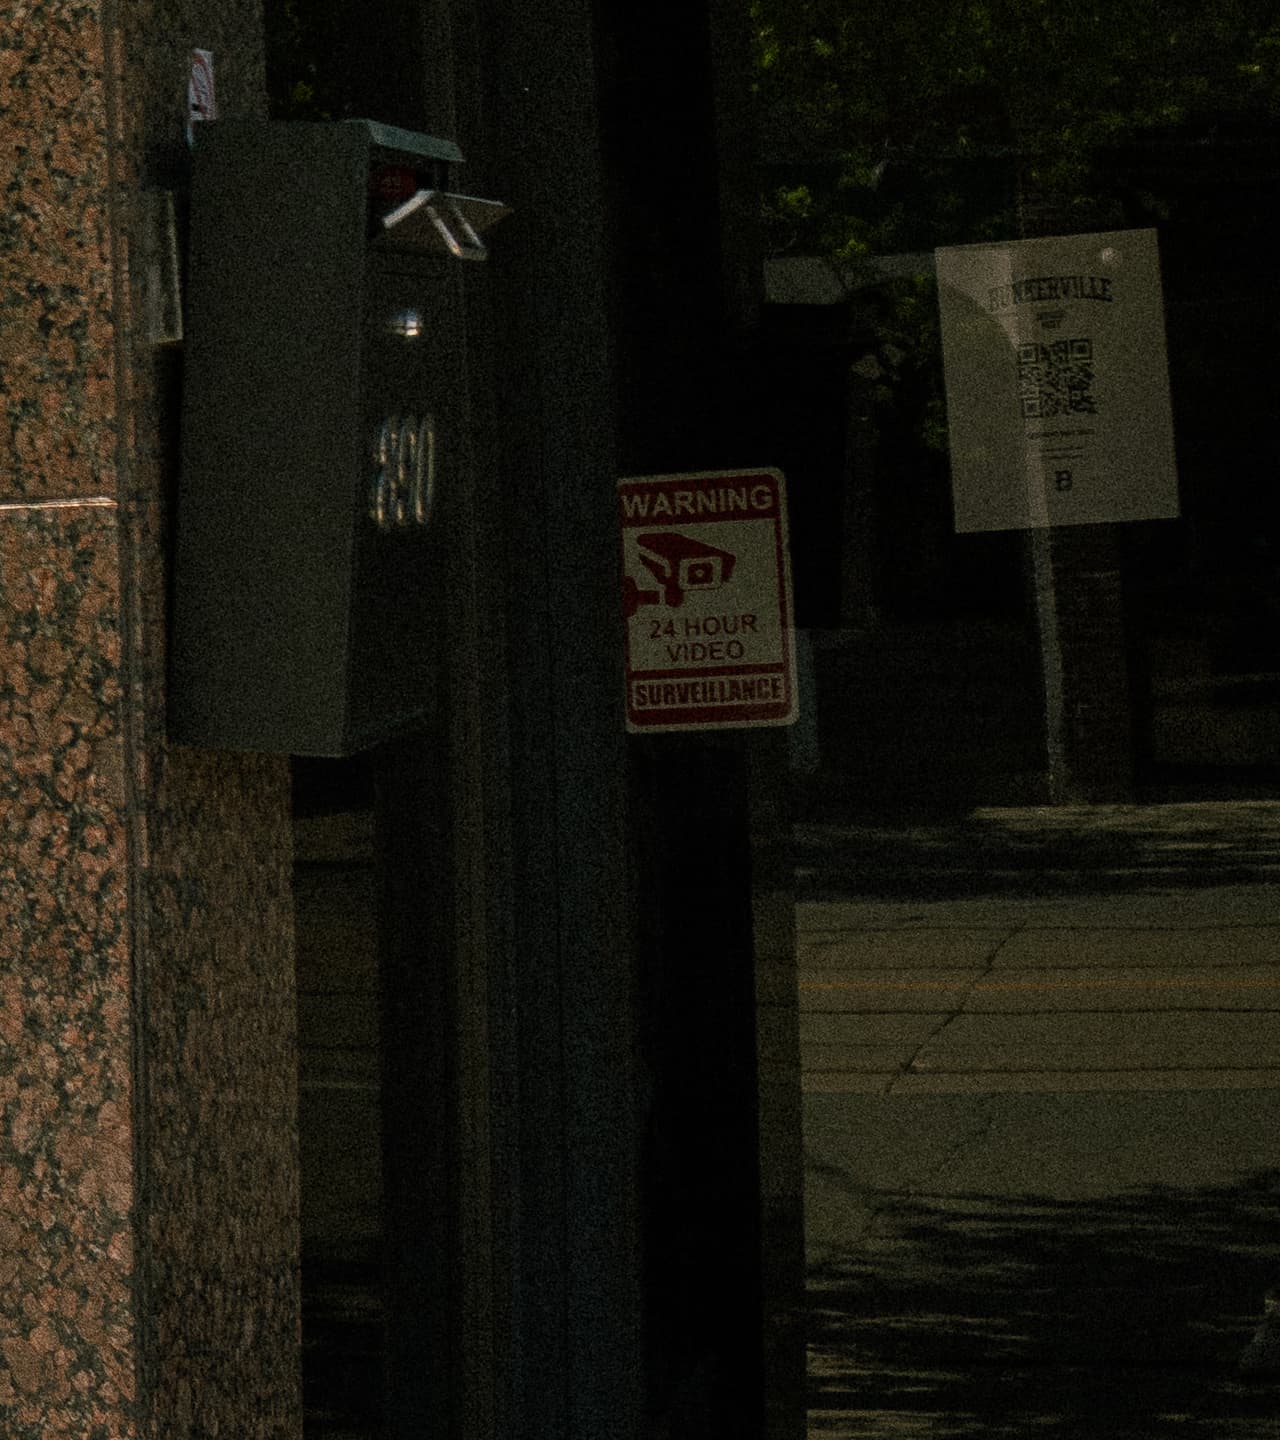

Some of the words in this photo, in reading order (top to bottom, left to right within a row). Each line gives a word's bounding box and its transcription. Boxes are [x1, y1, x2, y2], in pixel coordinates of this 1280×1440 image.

[621, 486, 774, 517] WARNING
[650, 619, 676, 638] 24
[685, 614, 759, 636] HOUR
[667, 640, 744, 663] VIDEO
[636, 678, 782, 706] SURVEILLANCE
